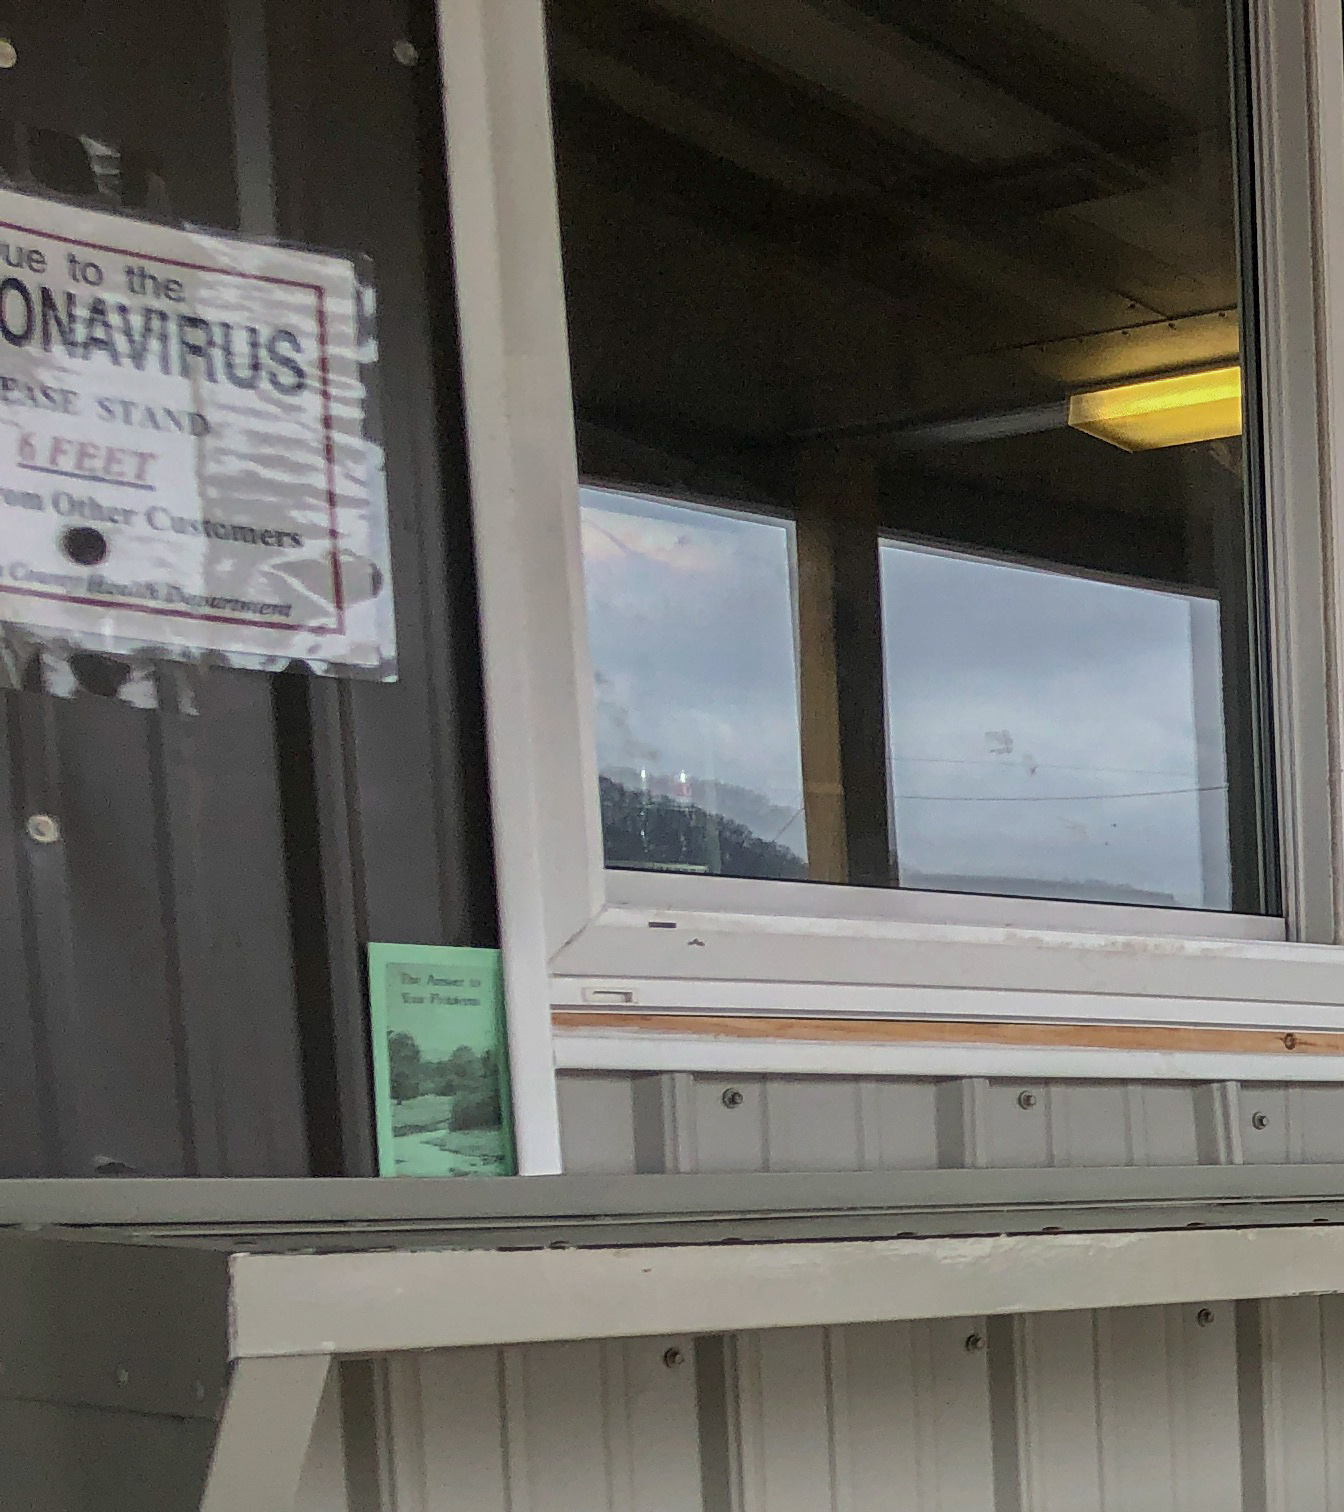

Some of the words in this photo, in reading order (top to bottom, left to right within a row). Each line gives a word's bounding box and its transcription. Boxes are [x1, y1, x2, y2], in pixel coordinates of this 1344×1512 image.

[0, 243, 47, 274] ue
[66, 250, 104, 287] to
[125, 264, 186, 302] the
[0, 277, 307, 397] ONAVIRUS
[0, 376, 80, 415] EASE
[96, 395, 212, 438] STAND
[18, 431, 36, 462] 6
[50, 435, 159, 482] FEET
[144, 504, 304, 549] Customers
